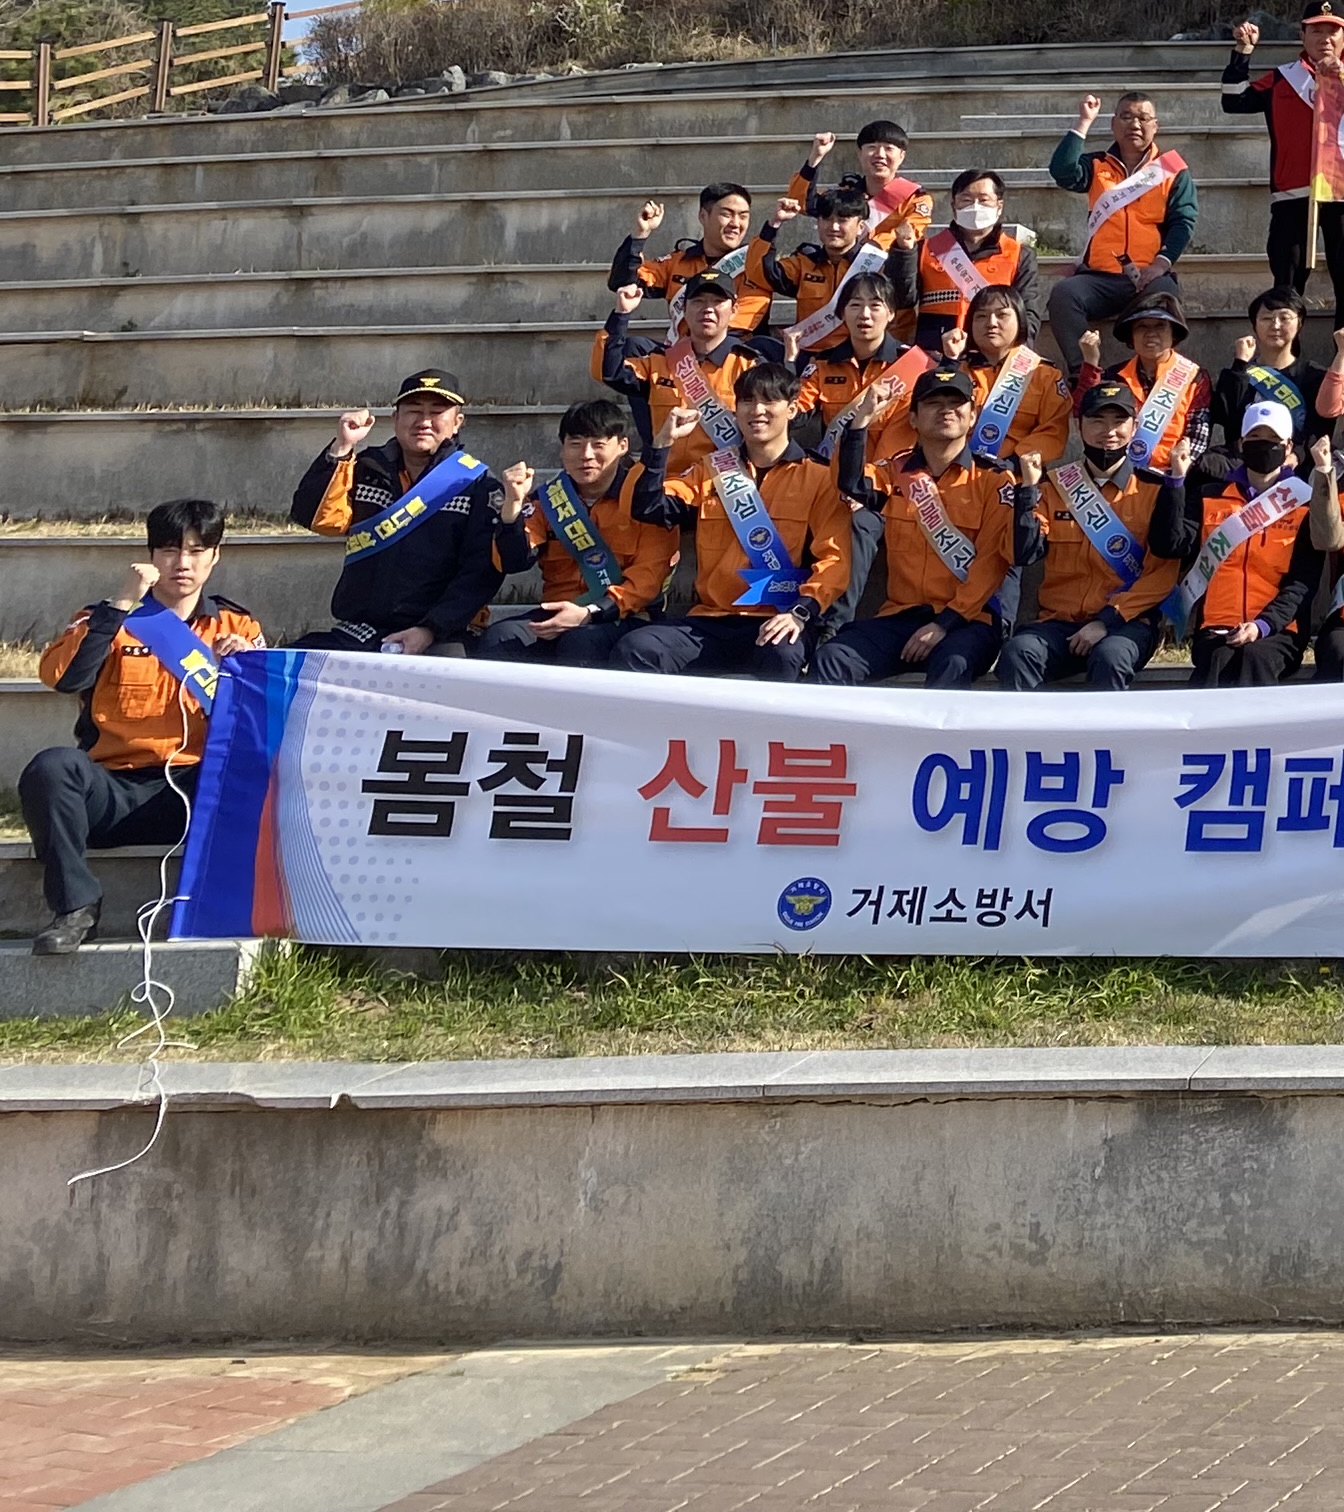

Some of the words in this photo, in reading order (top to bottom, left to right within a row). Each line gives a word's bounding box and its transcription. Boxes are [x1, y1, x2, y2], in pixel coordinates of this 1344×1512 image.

[675, 355, 739, 443] 산불조심
[1200, 486, 1299, 581] 산불조심
[360, 729, 585, 842] 봄철
[637, 739, 859, 846] 산불
[911, 747, 1126, 854] 예방
[845, 884, 1054, 928] 거제소방서
